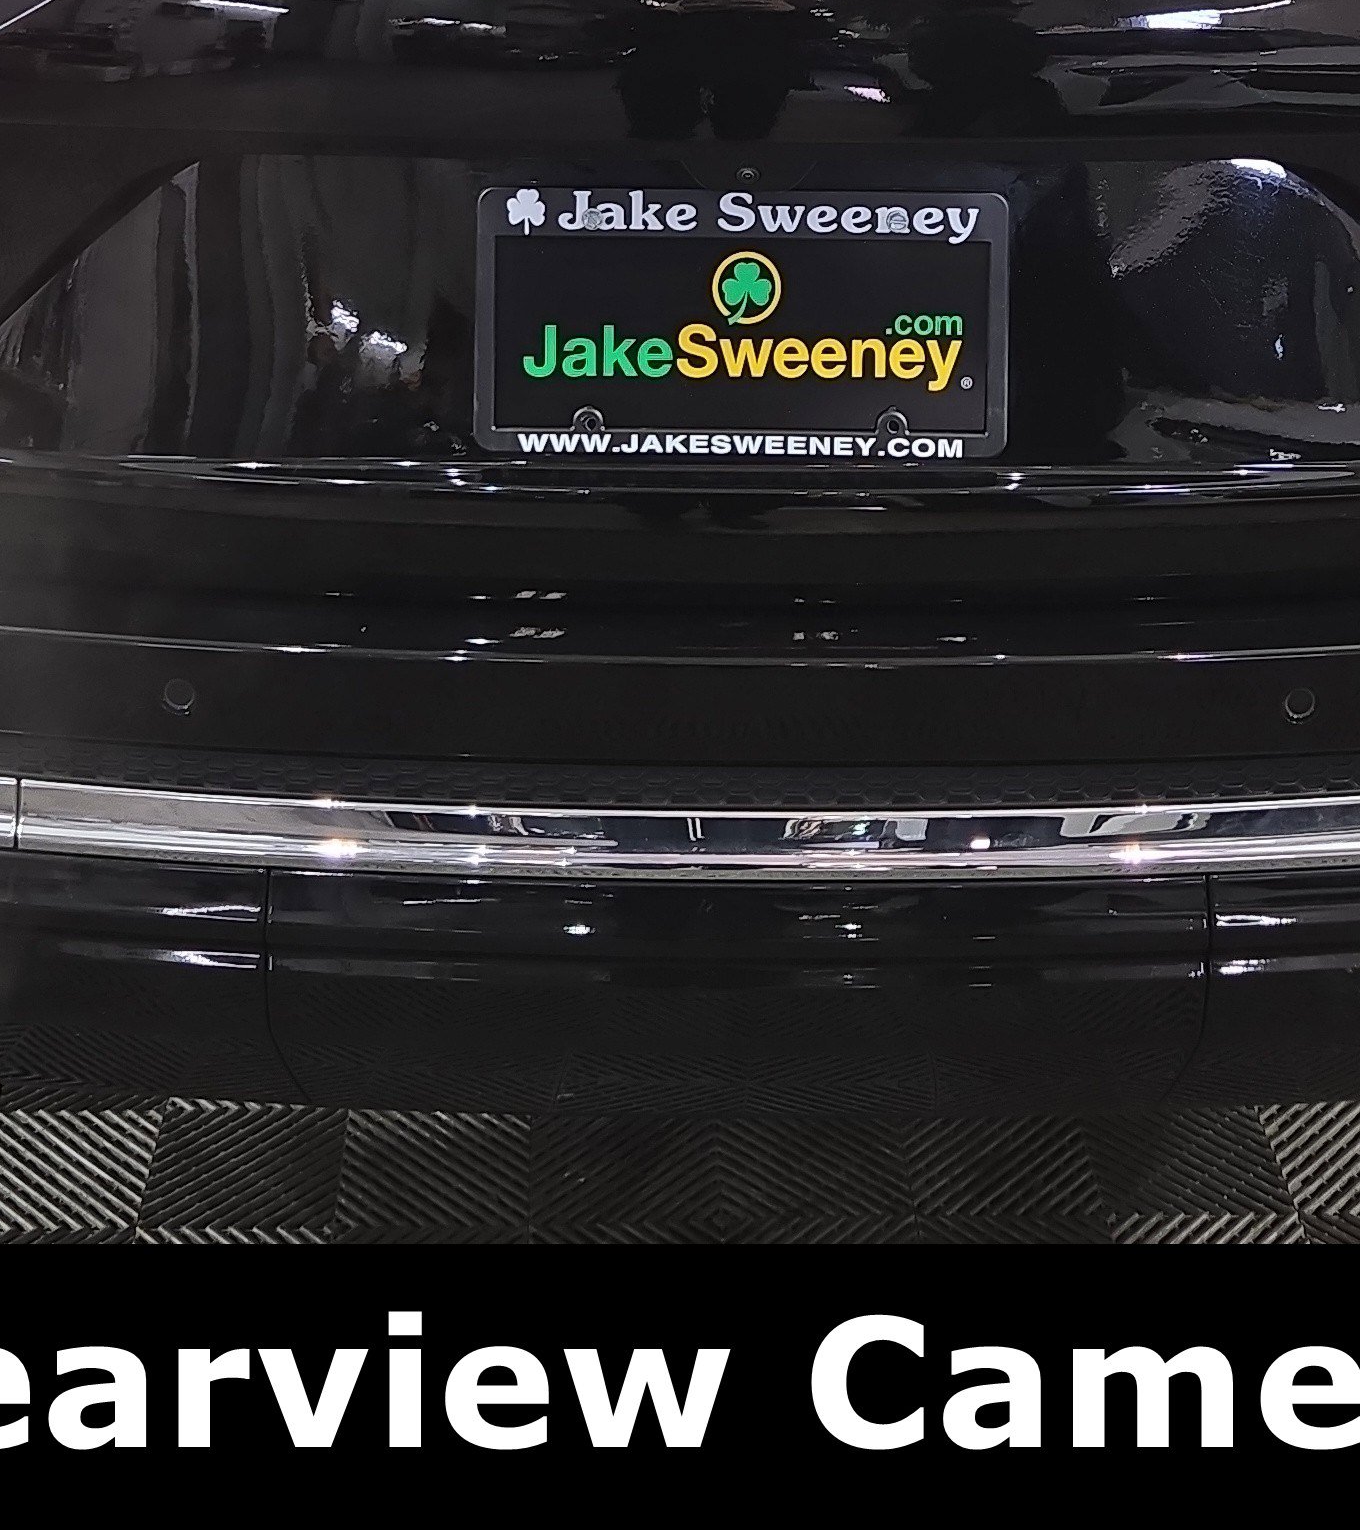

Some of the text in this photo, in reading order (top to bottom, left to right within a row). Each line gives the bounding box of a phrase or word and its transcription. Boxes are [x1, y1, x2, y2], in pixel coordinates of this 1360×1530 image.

[558, 190, 980, 244] Jake Sweeney
[885, 314, 963, 336] .com
[517, 432, 964, 459] WWW.JAKESWEENEY.COM
